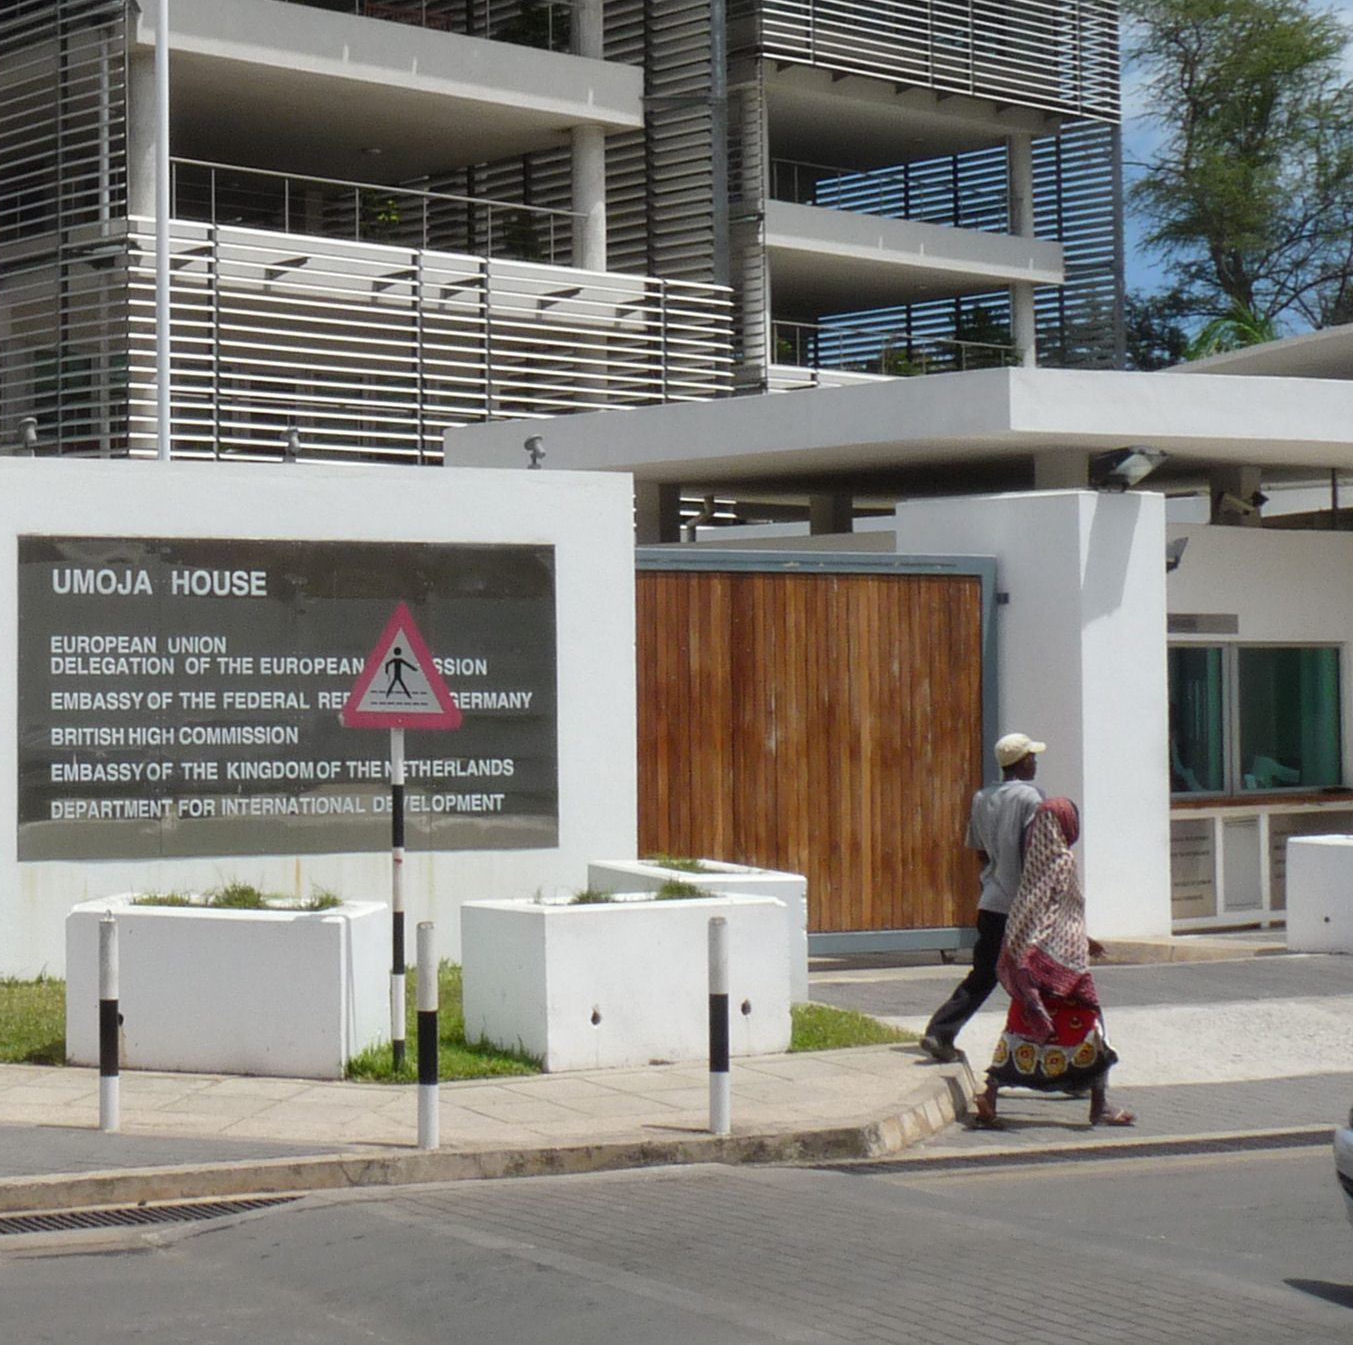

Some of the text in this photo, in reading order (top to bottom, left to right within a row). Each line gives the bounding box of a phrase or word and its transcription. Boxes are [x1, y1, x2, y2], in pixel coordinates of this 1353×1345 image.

[52, 569, 267, 596] UMOJA HOUSE
[50, 636, 226, 653] EUROPEAN UNION
[51, 657, 174, 674] DELEGATION
[185, 657, 210, 674] OF
[217, 657, 254, 674] THE
[260, 657, 365, 675] EUROPEAN
[51, 692, 144, 710] EMBASSY
[147, 692, 173, 710] OF
[179, 692, 216, 709] THE
[223, 691, 310, 709] FEDERAL
[51, 726, 298, 745] BRITISH HIGH COMMISSION
[51, 762, 144, 781] EMBASSY
[146, 762, 173, 781] OF
[181, 762, 218, 780] THE
[227, 761, 314, 779] KINGDOM
[316, 761, 341, 778] OF
[347, 760, 382, 778] THE
[51, 800, 174, 819] DEPARTMENT
[178, 799, 216, 817] FOR
[221, 797, 365, 816] INTERNATIONAL
